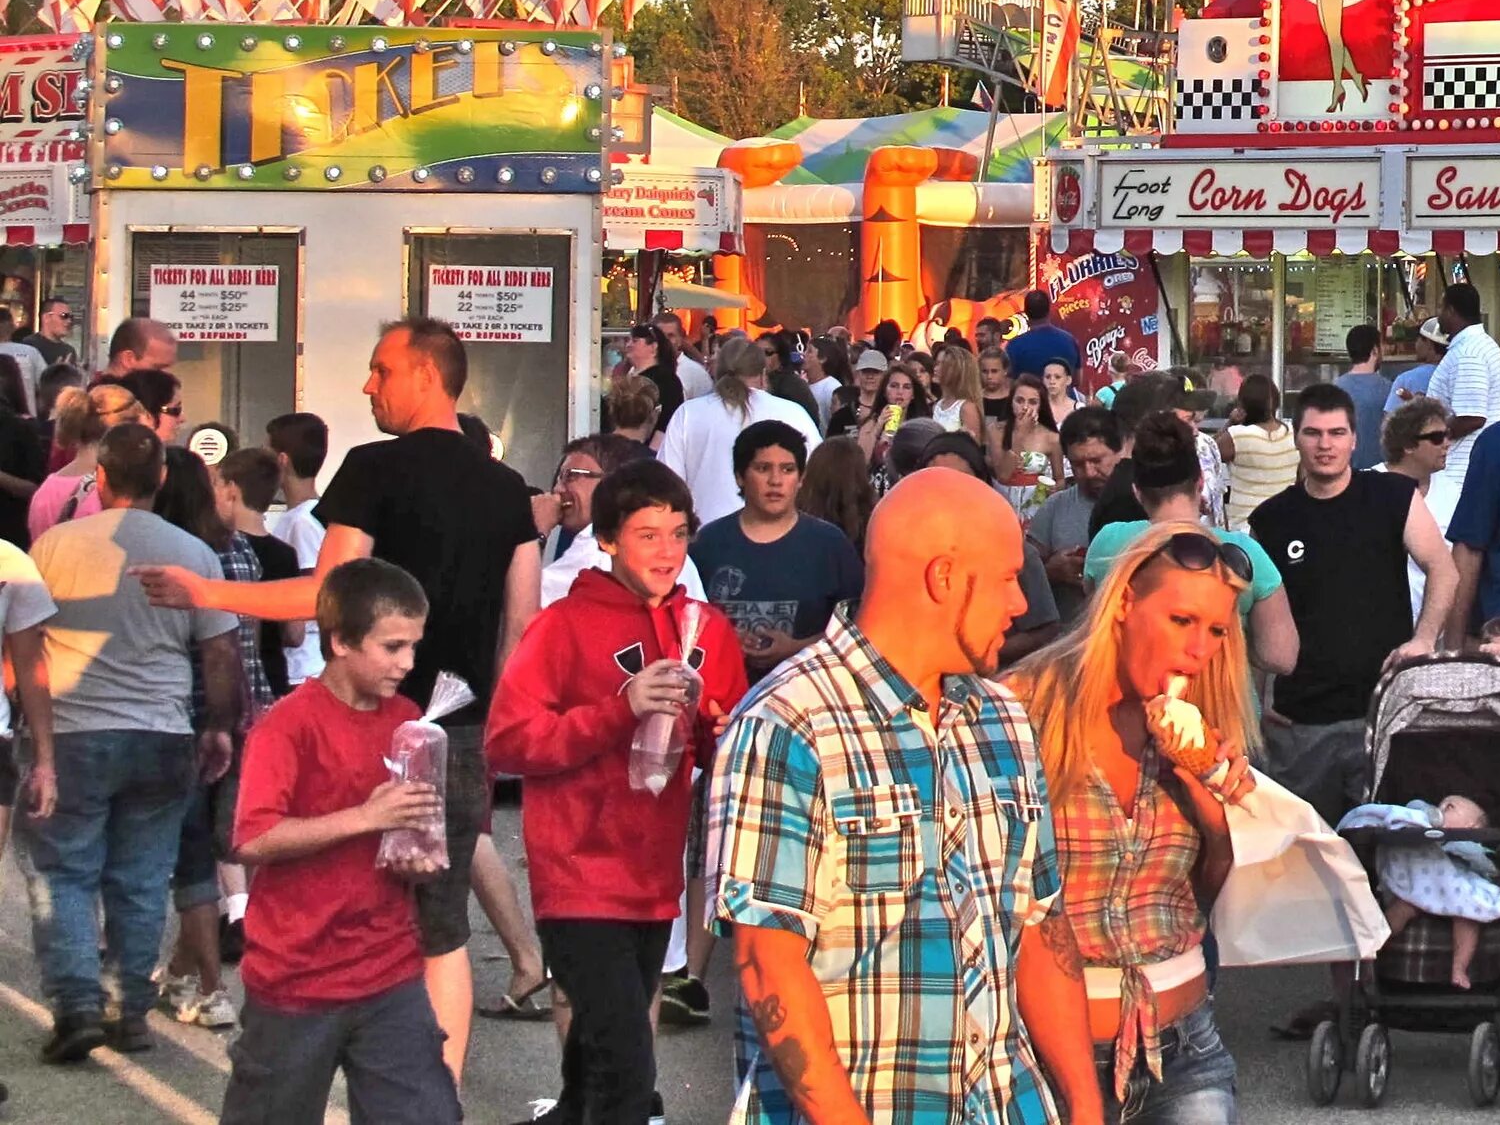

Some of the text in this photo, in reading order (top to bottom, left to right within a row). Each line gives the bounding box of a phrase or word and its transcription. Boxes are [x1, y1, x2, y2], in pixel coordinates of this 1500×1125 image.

[635, 186, 696, 204] Daiquiris
[1113, 168, 1367, 223] Foot Corn Dogs
[648, 204, 696, 219] Cones
[1113, 193, 1165, 221] Long
[154, 269, 276, 285] TICKETS FOR ALL RIDES HERE
[432, 269, 551, 287] TICKETS FOR ALL RIDES HERE
[180, 290, 195, 300] 44
[458, 290, 472, 300] 44
[180, 302, 195, 312] 22
[457, 302, 472, 312] 22
[510, 323, 543, 331] TICKETS
[476, 332, 522, 340] REFUNDS
